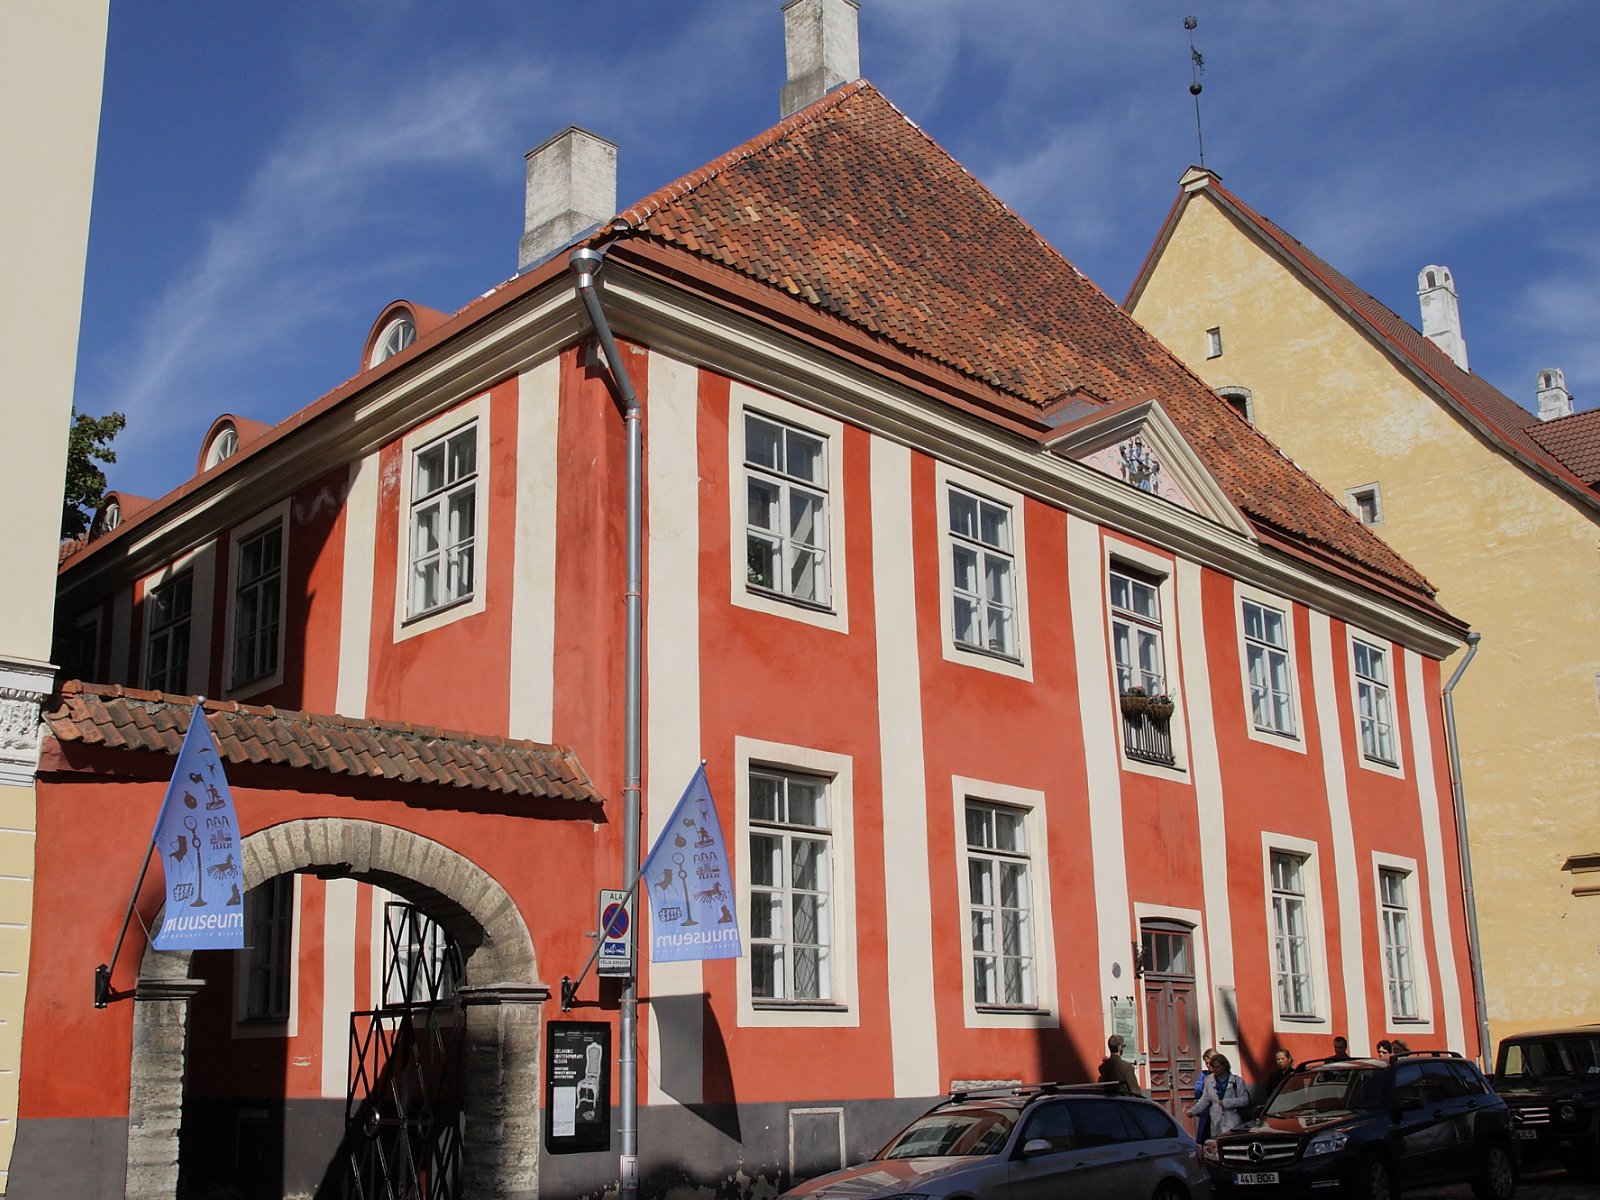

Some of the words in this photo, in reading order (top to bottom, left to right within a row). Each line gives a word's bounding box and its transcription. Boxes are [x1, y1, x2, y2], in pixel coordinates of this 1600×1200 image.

[609, 892, 623, 901] ALA
[163, 912, 243, 933] muuseum
[1240, 1174, 1253, 1184] 441
